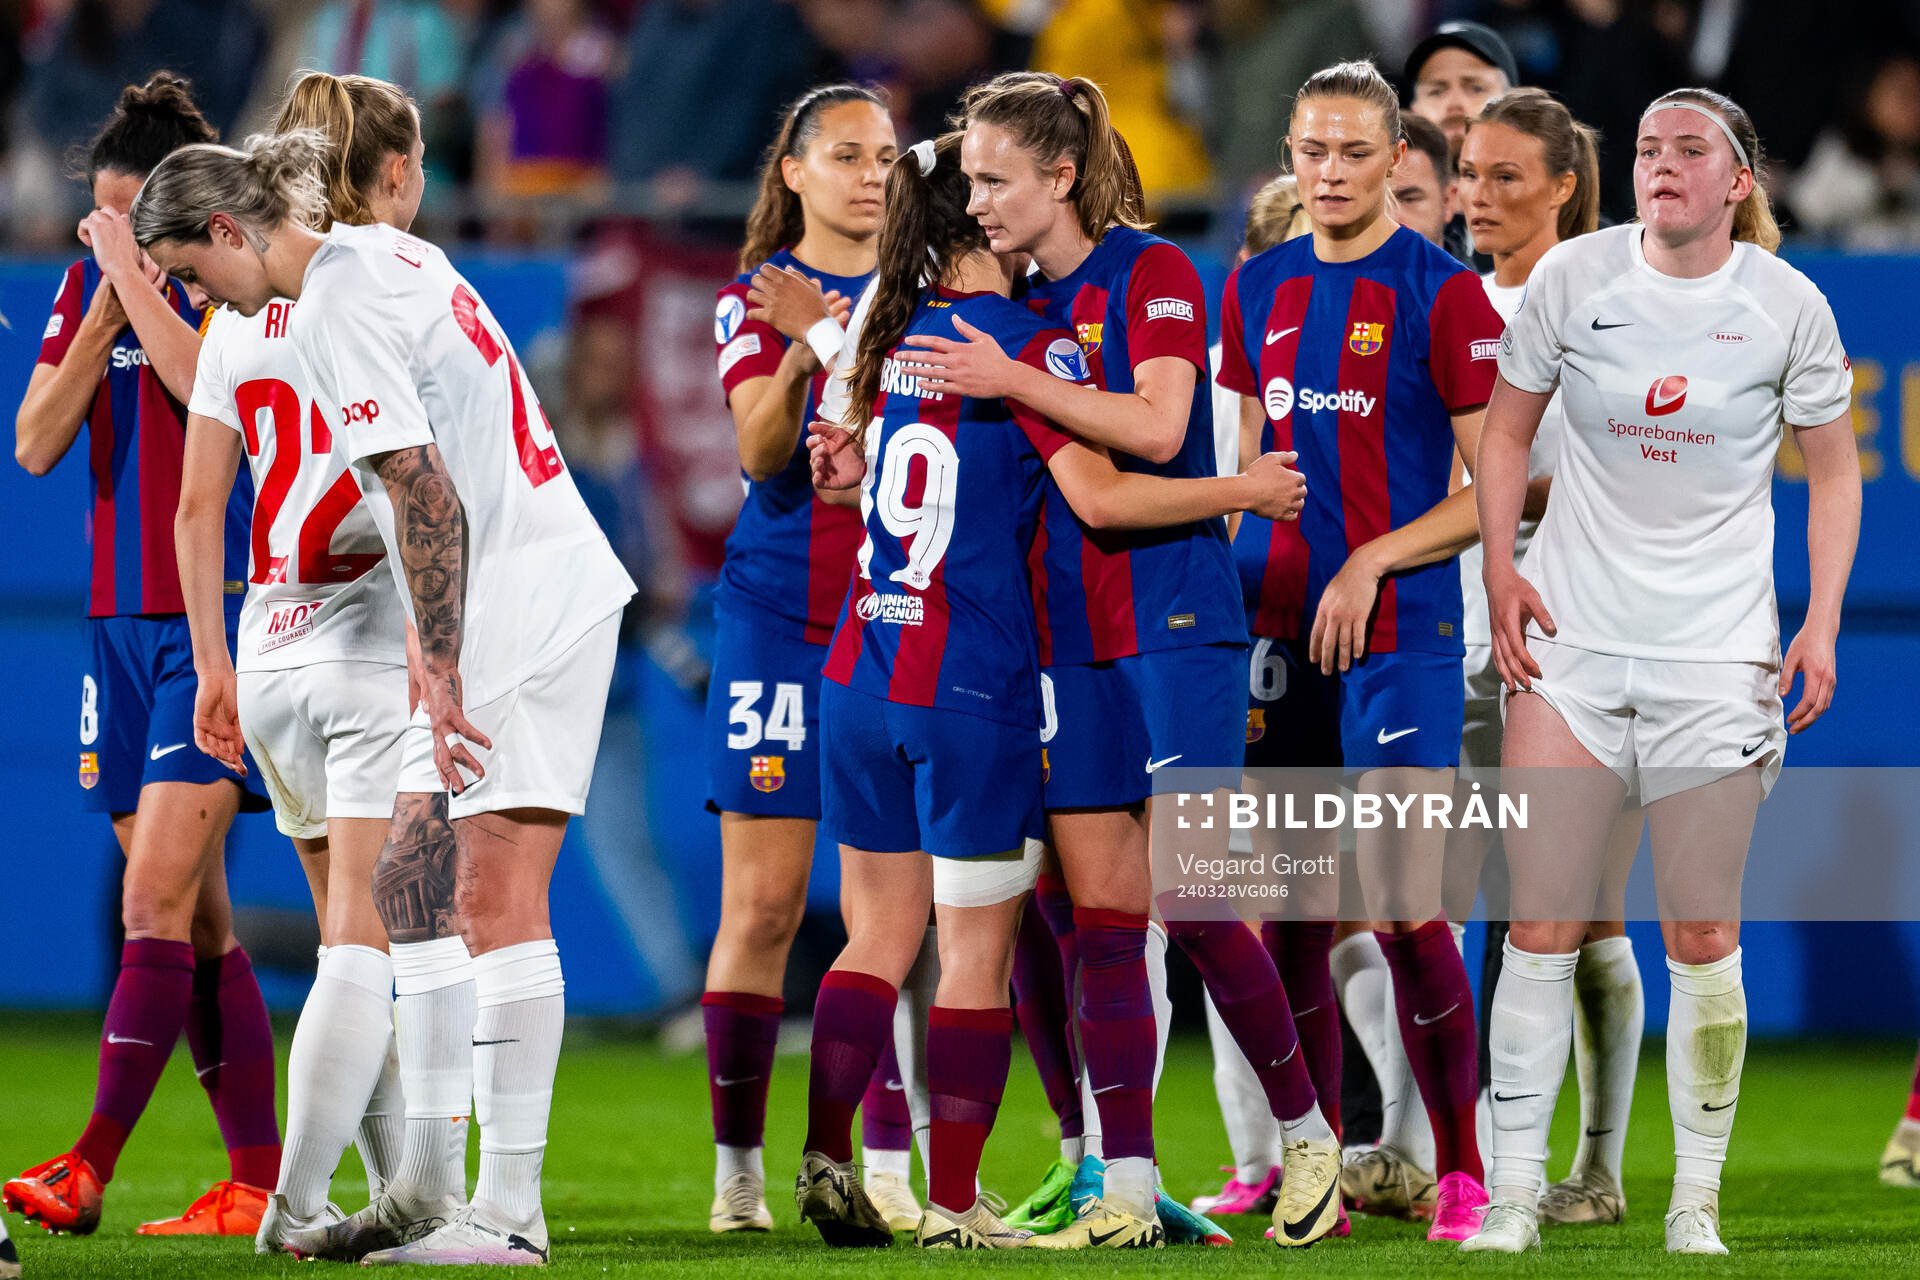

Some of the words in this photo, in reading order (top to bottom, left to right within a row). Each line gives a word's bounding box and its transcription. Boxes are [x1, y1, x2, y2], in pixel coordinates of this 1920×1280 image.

[264, 303, 296, 338] RI
[1147, 301, 1194, 319] BIMBO
[1716, 333, 1744, 341] BRANN
[1298, 388, 1376, 417] Spotify
[1607, 418, 1716, 445] Sparebanken
[1640, 443, 1678, 464] Vest
[857, 416, 960, 591] 19
[882, 594, 923, 608] UNHCR
[80, 674, 99, 745] 8
[727, 681, 807, 751] 34
